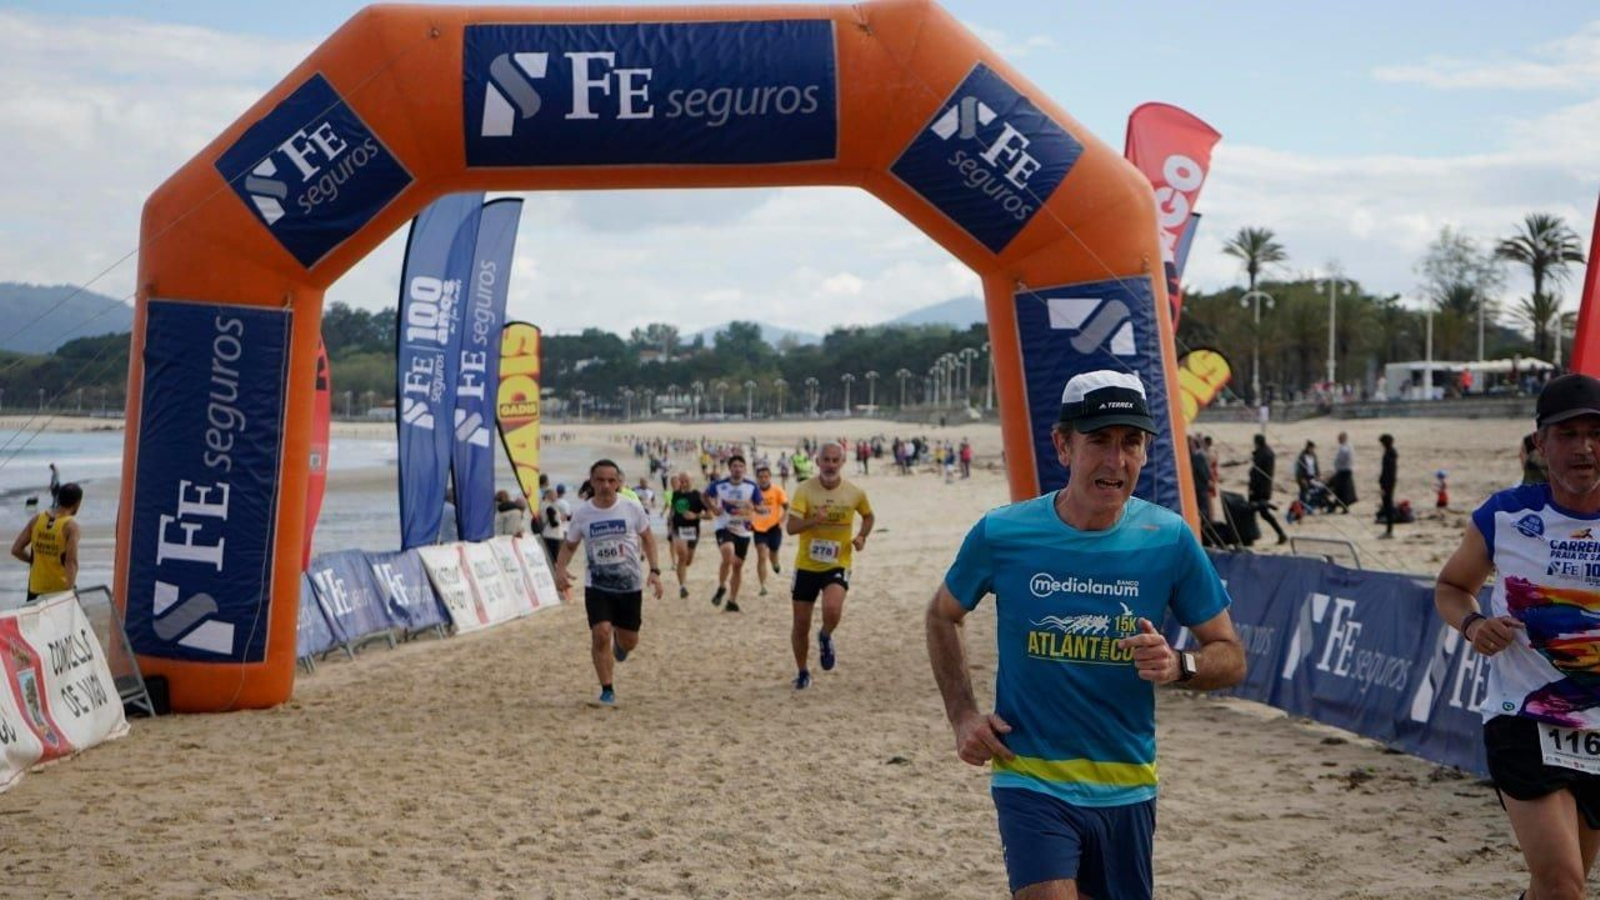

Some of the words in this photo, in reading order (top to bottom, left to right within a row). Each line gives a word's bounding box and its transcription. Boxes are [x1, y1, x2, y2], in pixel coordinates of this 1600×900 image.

[564, 50, 654, 120] FE
[665, 83, 819, 127] seguros
[277, 121, 348, 183] FE
[297, 137, 379, 215] seguros
[979, 121, 1042, 190] FE
[947, 150, 1034, 221] seguros
[406, 276, 442, 343] 100
[457, 351, 486, 401] FE
[473, 259, 497, 347] seguros
[403, 356, 434, 396] FE
[430, 354, 447, 404] seguros
[500, 402, 538, 416] GADIS
[156, 479, 230, 572] FE
[204, 315, 246, 472] seguros
[812, 545, 832, 556] 278
[1550, 550, 1577, 560] PRAIA
[1561, 562, 1580, 576] FE
[1030, 573, 1139, 598] mediolanum
[1115, 615, 1137, 632] 15K
[1316, 597, 1362, 676] FE
[1350, 648, 1413, 694] seguros
